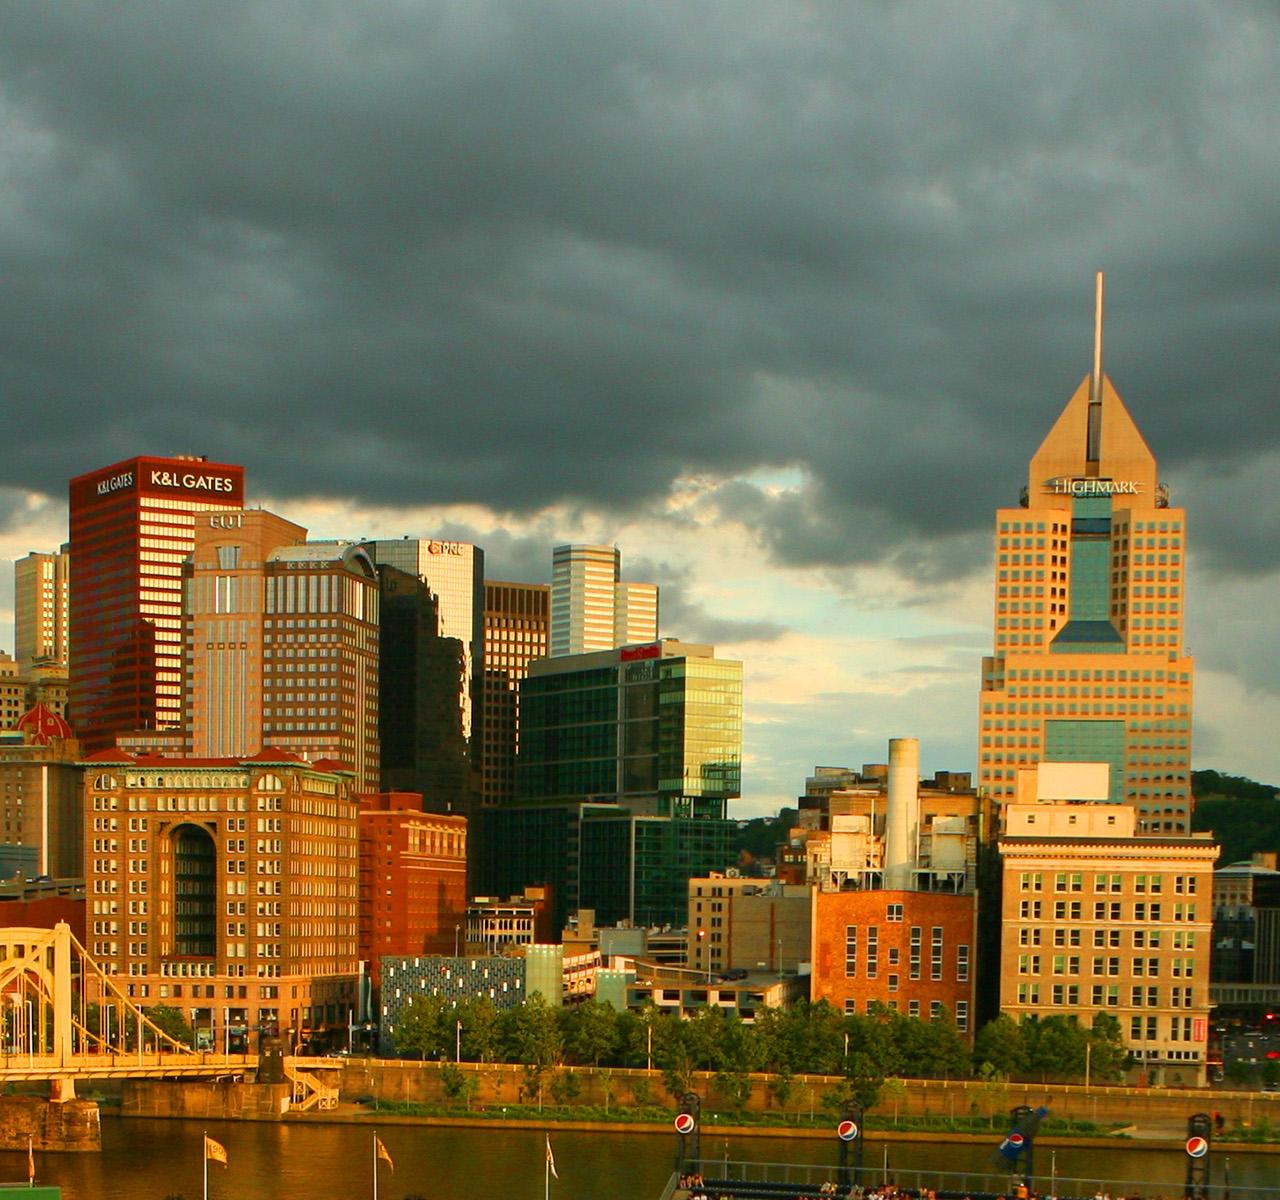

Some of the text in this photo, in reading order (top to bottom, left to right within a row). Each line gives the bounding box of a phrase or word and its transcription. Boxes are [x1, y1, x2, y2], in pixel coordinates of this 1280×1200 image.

[111, 472, 133, 490] GATES
[151, 471, 233, 492] K&L GATES
[1055, 478, 1139, 495] HIGHMARK
